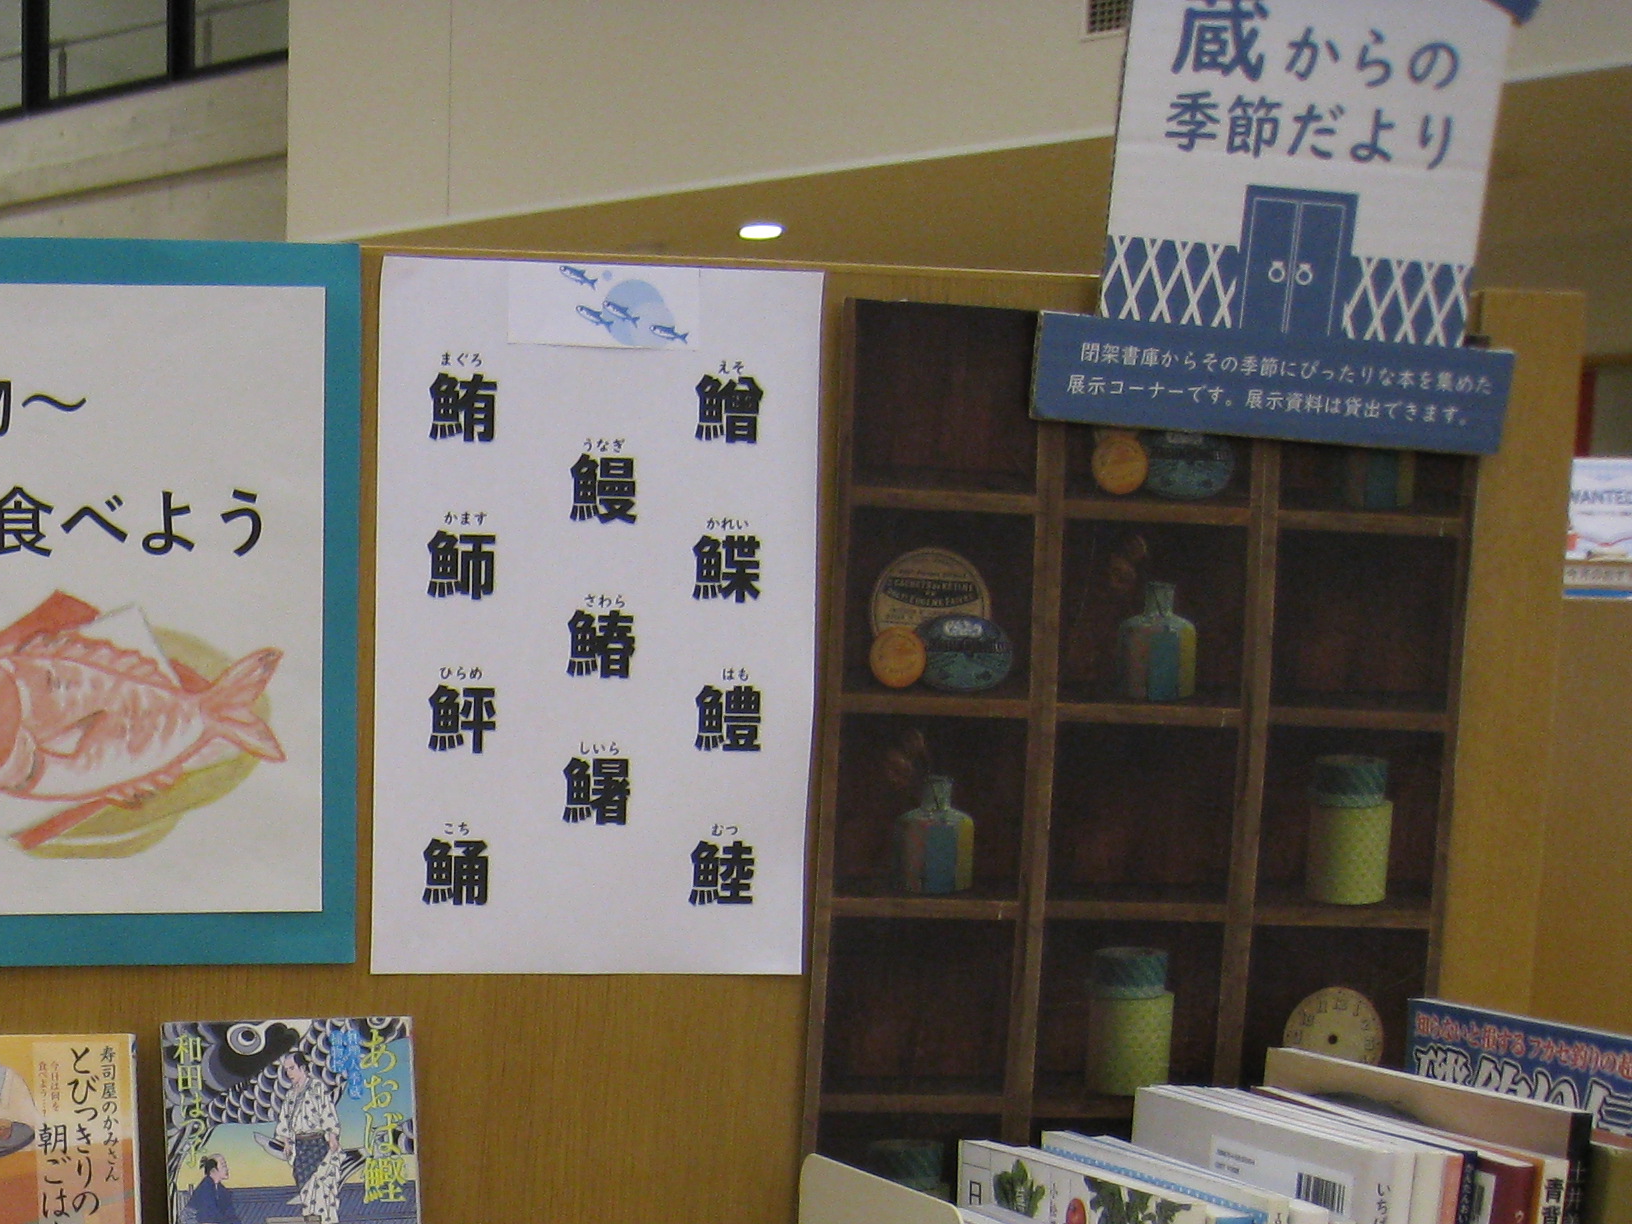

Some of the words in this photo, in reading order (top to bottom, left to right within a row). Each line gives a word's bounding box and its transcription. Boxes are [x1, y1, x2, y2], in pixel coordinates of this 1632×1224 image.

[1170, 0, 1460, 91] 蔵からの
[1164, 90, 1455, 170] 季節だより
[440, 353, 483, 366] まぐろ
[719, 361, 745, 374] えそ
[1079, 341, 1493, 397] 閉架書庫からその季節にぴったりな本を集めた
[428, 372, 497, 442] 鮪
[583, 439, 625, 453] うなぎ
[444, 512, 487, 525] かます
[569, 453, 637, 524] 鰻
[707, 517, 749, 530] かれい
[427, 530, 496, 600] 魳
[691, 534, 762, 603] 鰈
[584, 594, 625, 608] さわら
[440, 667, 483, 680] ひらめ
[567, 610, 634, 678] 鰆
[723, 667, 748, 680] はも
[428, 684, 496, 754] 鮃
[580, 742, 619, 755] しいら
[695, 685, 761, 752] 鱧
[444, 822, 469, 835] こち
[712, 824, 738, 836] むつ
[422, 838, 488, 905] 鯒
[689, 840, 754, 906] 鯥
[68, 1046, 101, 1217] とびっきりの
[99, 1045, 121, 1183] 寿司屋のかみさん
[172, 1034, 207, 1169] 和田はつ子
[359, 1028, 407, 1205] あおば鰹
